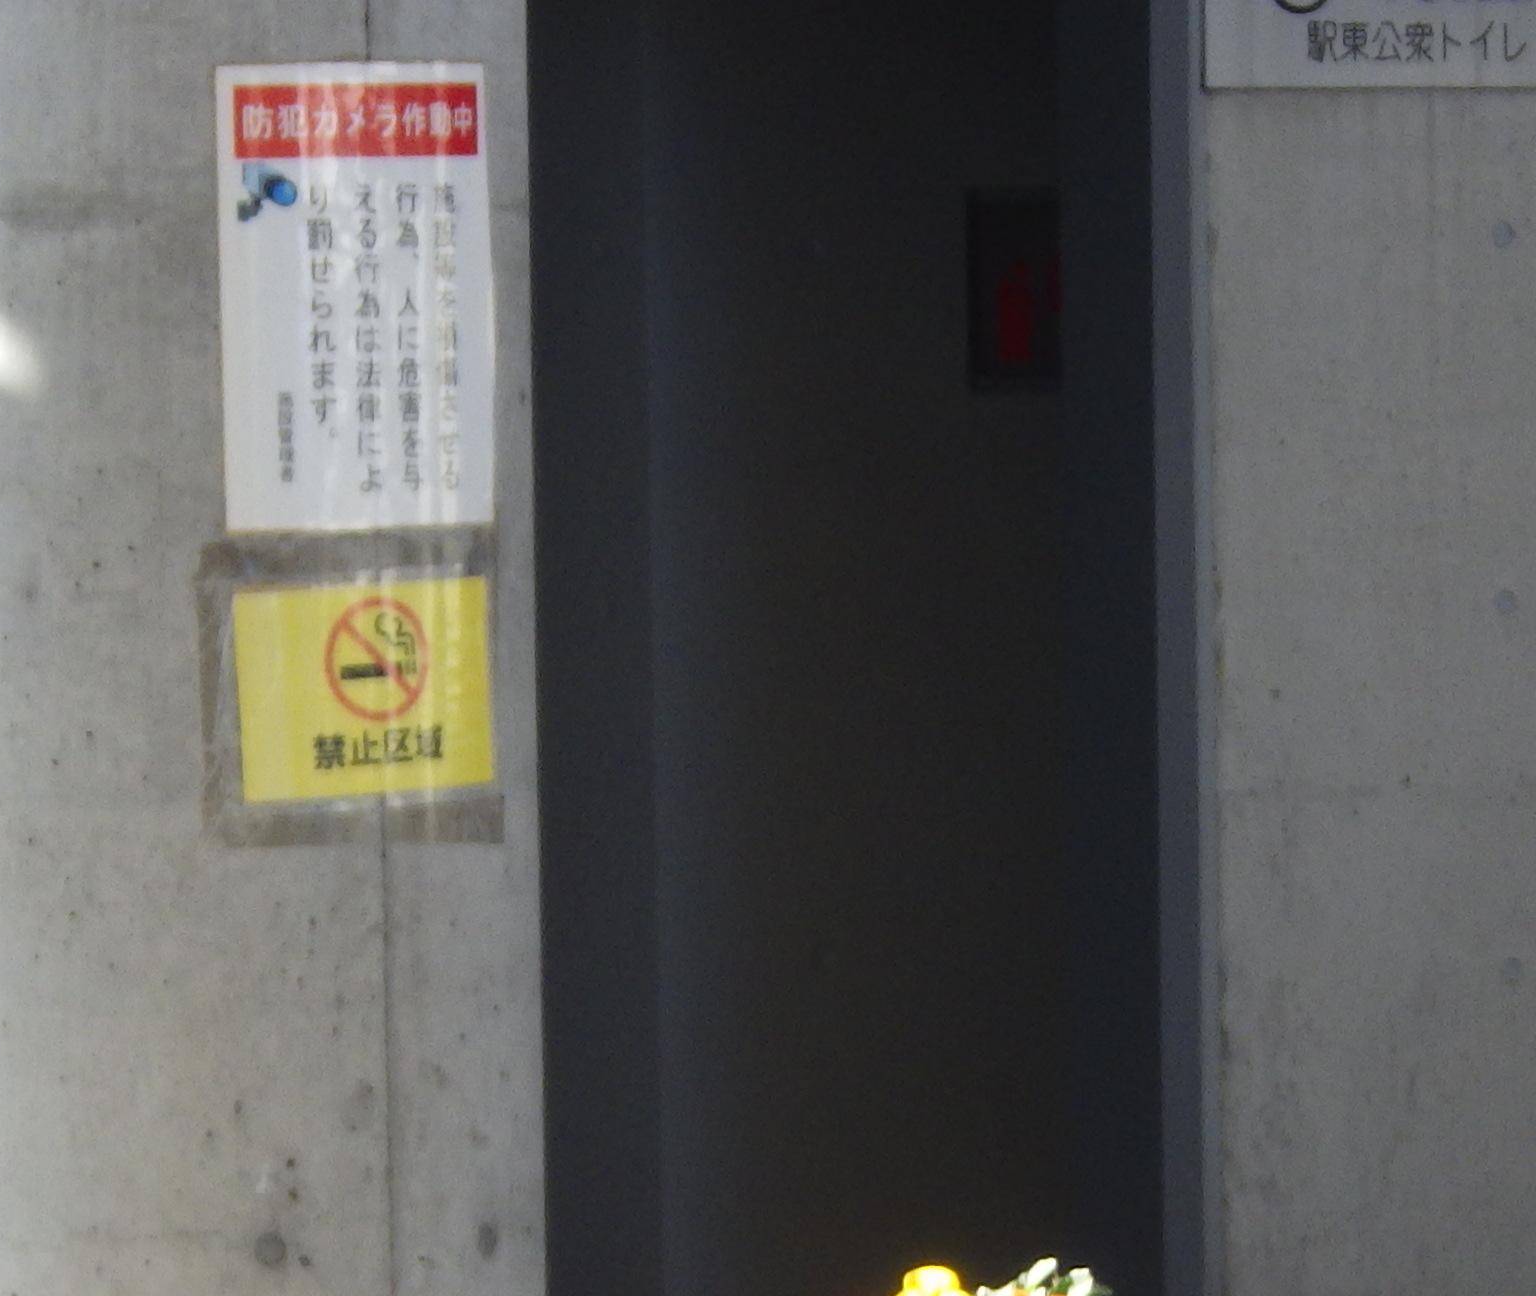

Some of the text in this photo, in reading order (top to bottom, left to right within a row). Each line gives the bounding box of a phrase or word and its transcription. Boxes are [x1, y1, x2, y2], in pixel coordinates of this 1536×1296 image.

[1306, 19, 1527, 63] 駅東公衆トイレ
[241, 102, 474, 140] 防犯カメラ作動中
[313, 724, 443, 770] 禁止区域
